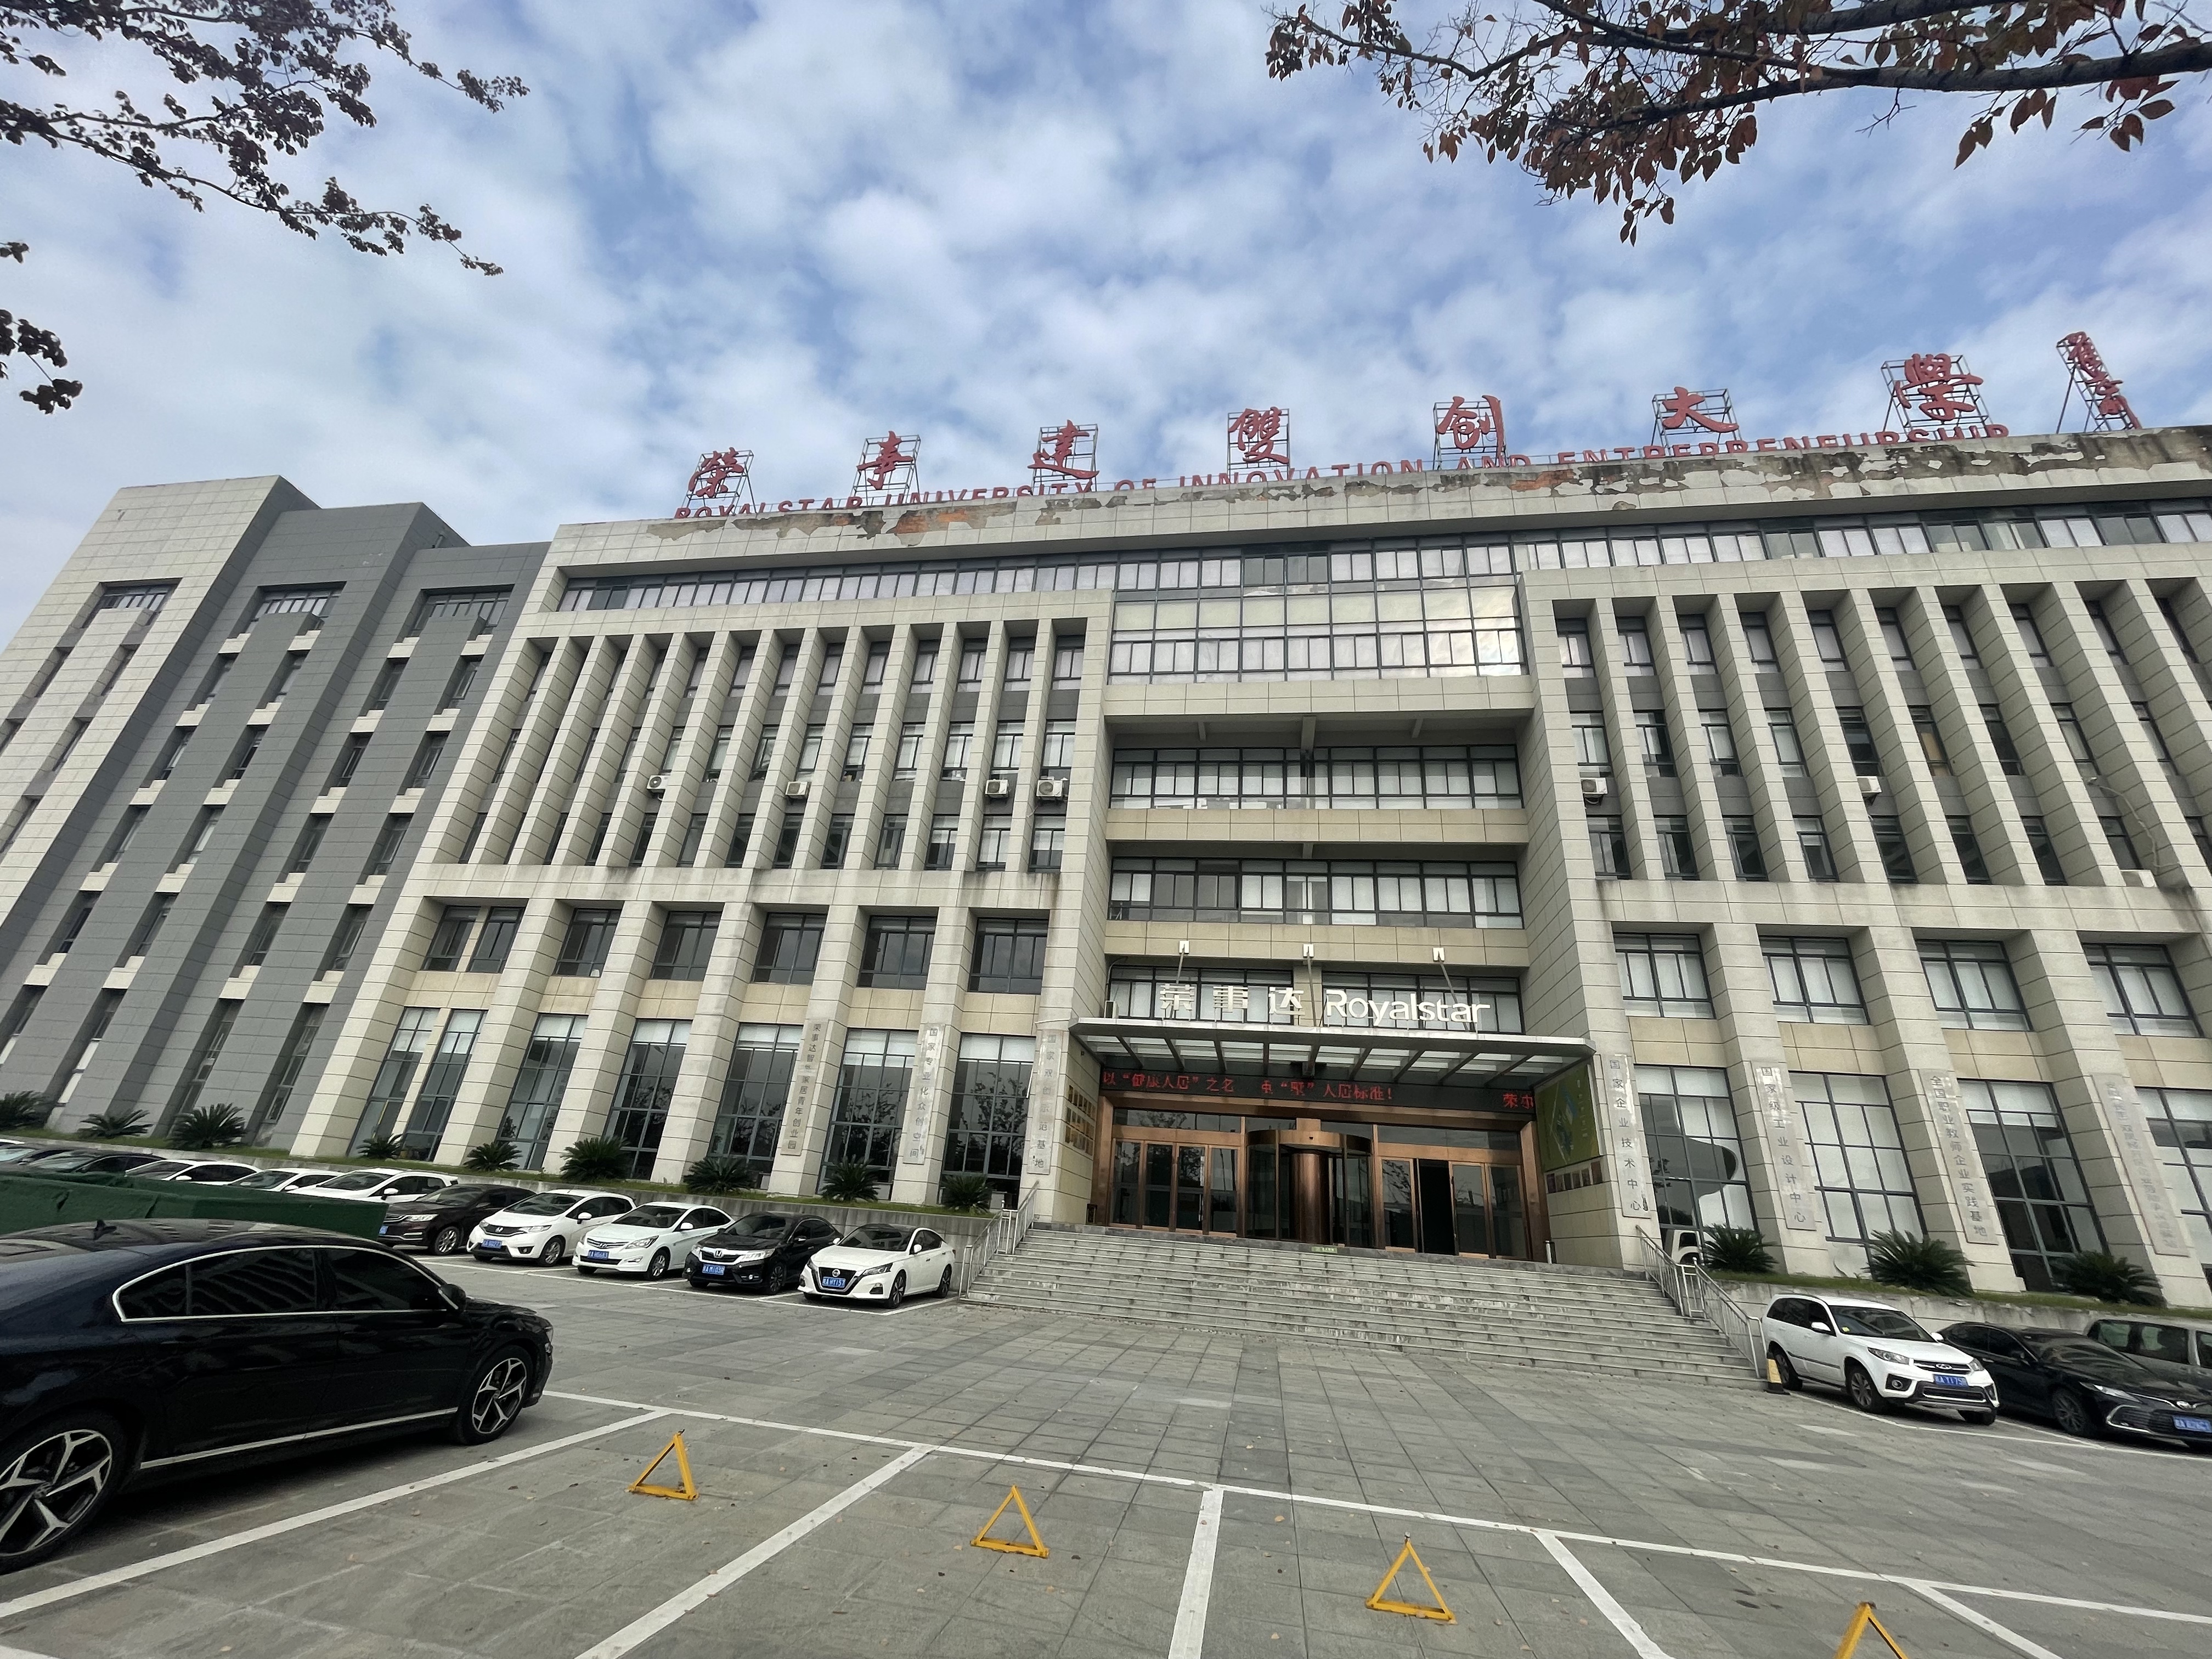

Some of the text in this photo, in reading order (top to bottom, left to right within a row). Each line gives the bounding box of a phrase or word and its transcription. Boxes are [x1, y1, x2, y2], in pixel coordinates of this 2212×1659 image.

[1457, 454, 1532, 470] AND
[1160, 983, 1490, 1026] 荣事达 Royalstar
[1610, 1059, 1641, 1211] 国家企业技术中心
[1762, 1066, 1806, 1223] 国家级工业设计中心
